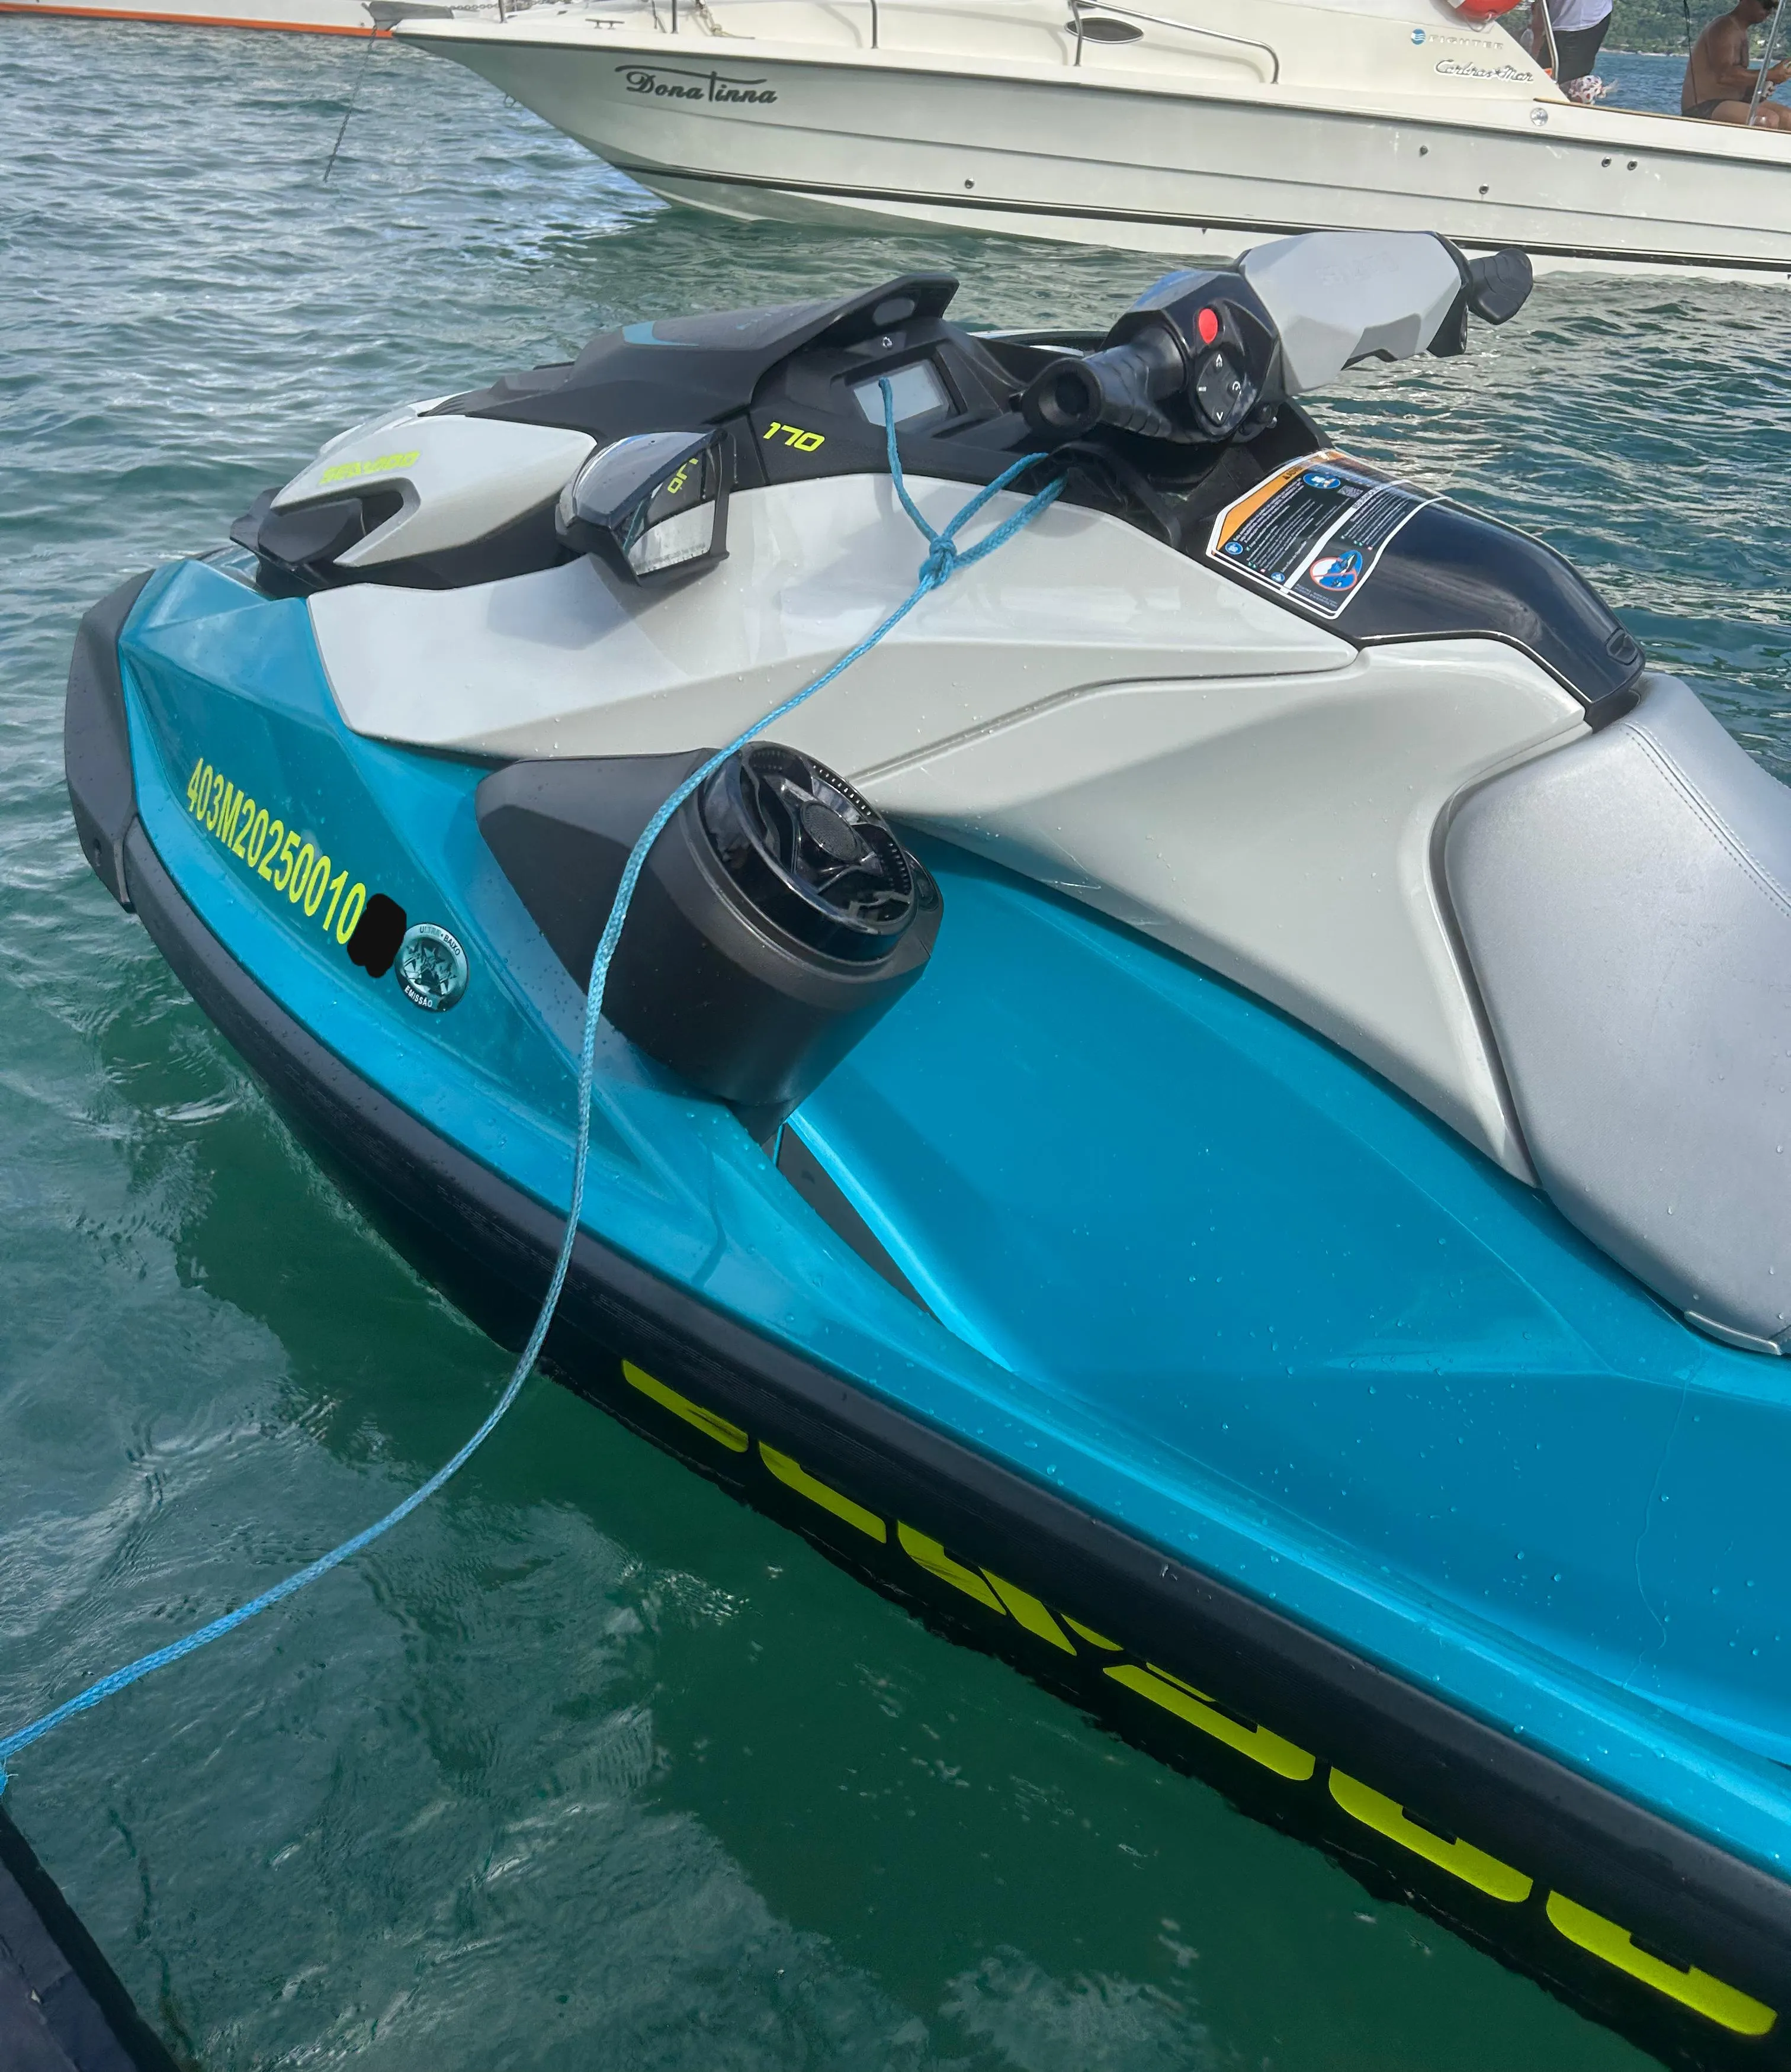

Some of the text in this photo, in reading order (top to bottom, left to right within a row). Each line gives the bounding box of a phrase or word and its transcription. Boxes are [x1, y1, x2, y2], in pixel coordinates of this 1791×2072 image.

[626, 70, 778, 103] Dona Tinna
[763, 422, 825, 452] 170
[187, 758, 366, 945] 403M20250010
[420, 926, 461, 956] ULTRA BAIXO
[405, 985, 433, 1007] EMISSÃO
